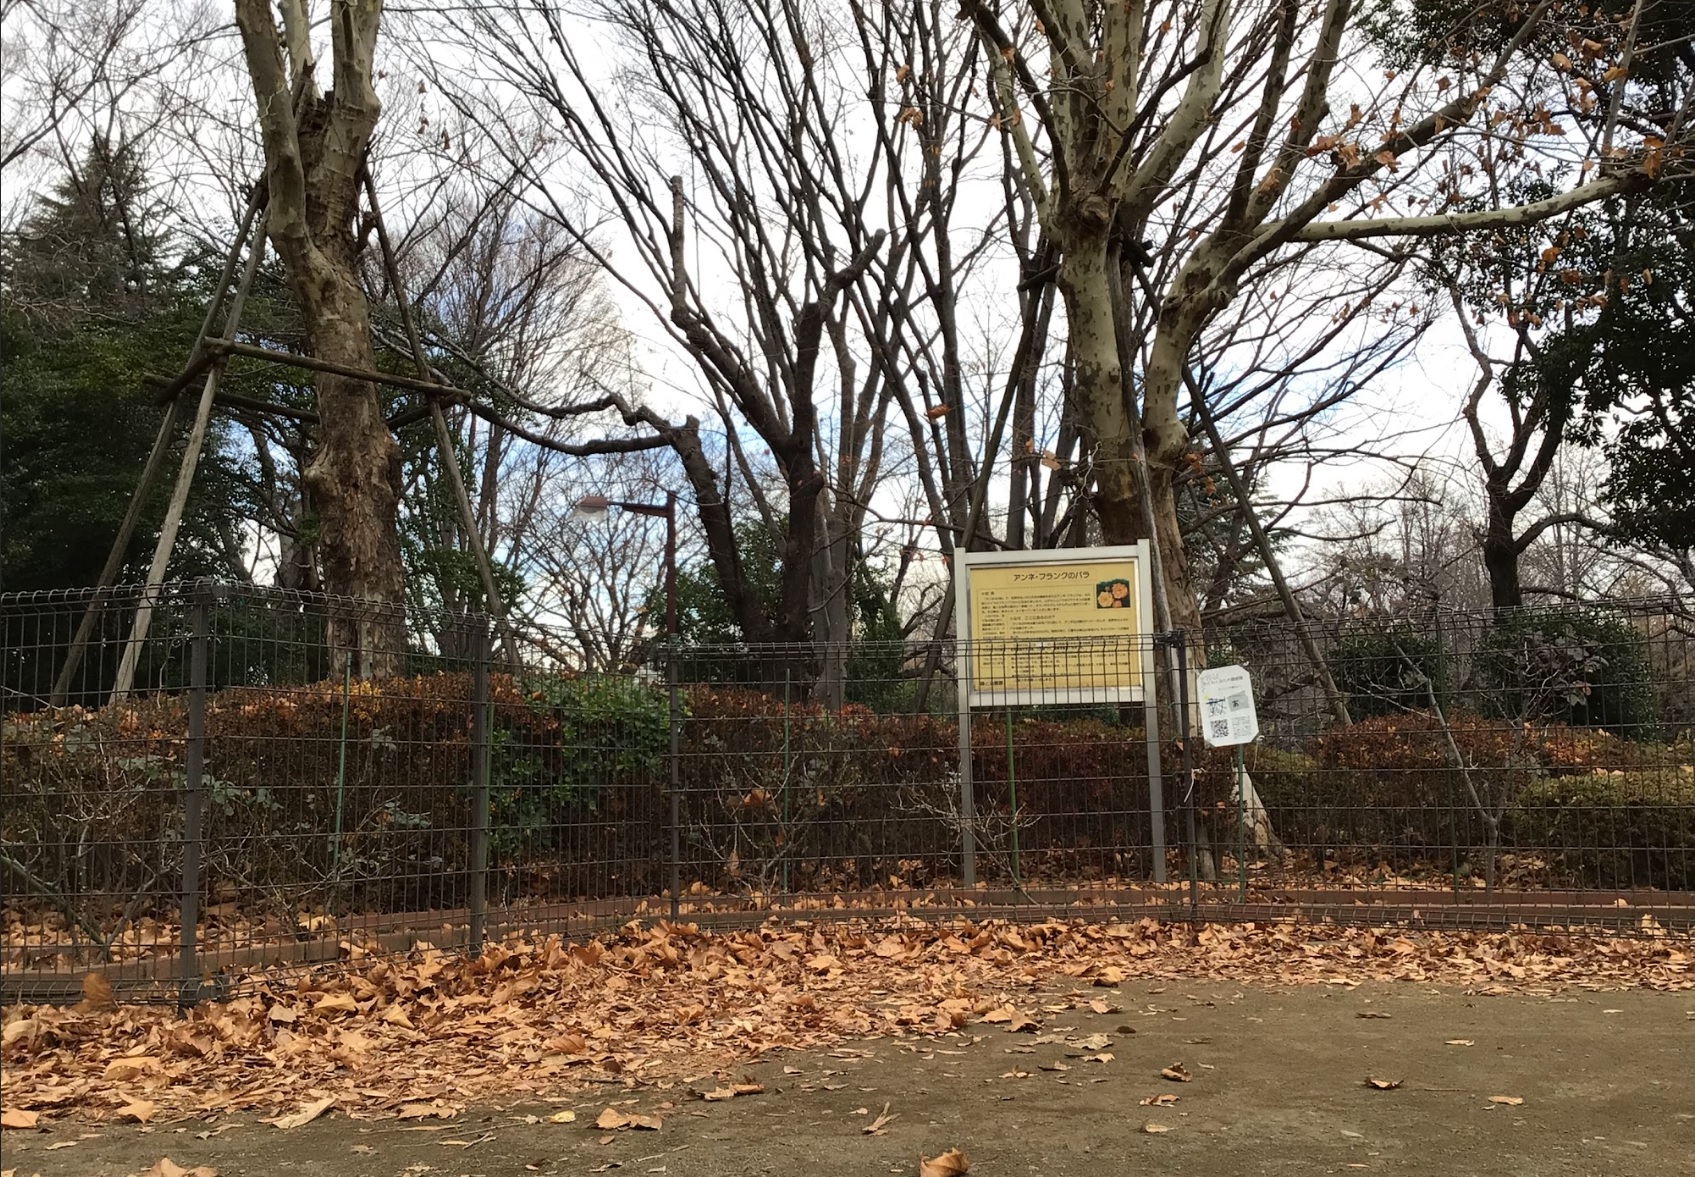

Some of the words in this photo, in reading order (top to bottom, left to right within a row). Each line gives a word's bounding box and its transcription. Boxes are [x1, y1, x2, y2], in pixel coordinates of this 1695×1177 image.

[1013, 571, 1090, 582] アンネ・フランクのバラ
